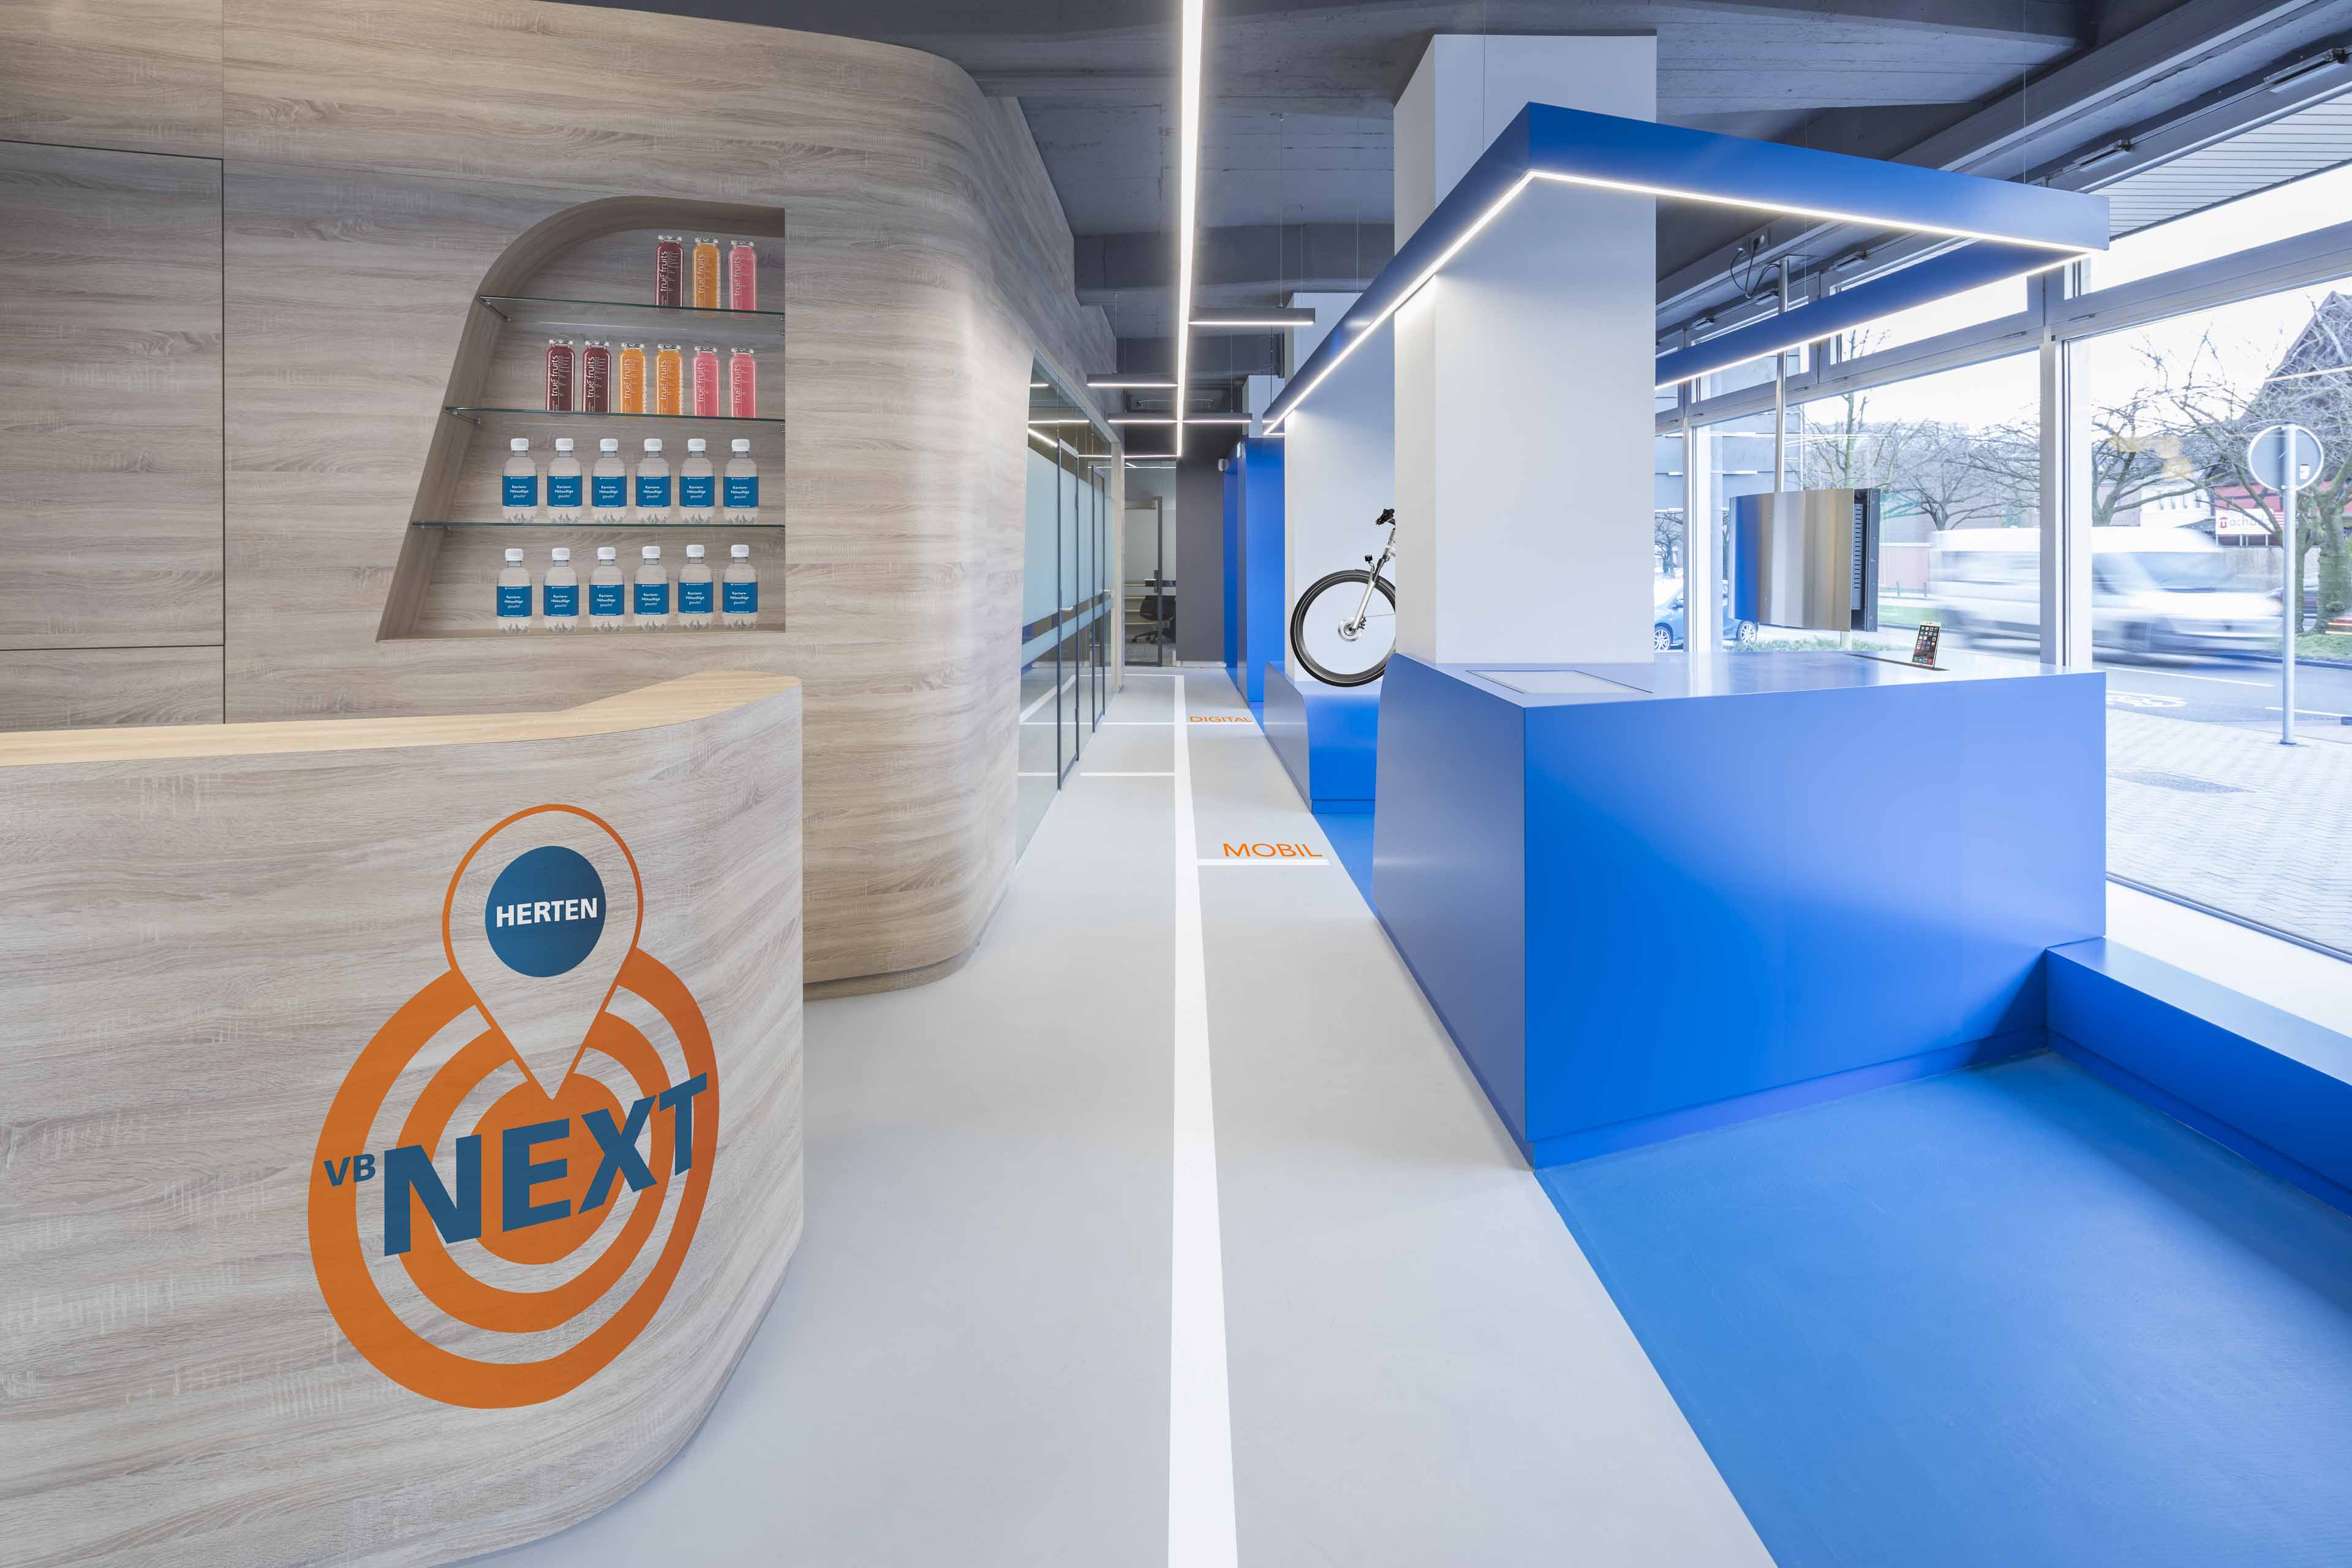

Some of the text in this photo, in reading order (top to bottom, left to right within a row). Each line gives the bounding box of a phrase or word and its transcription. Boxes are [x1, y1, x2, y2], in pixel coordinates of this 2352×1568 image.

[586, 356, 595, 379] fruits
[1223, 843, 1322, 858] MOBIL
[496, 897, 598, 927] HERTEN
[323, 1072, 707, 1257] VB NEXT
